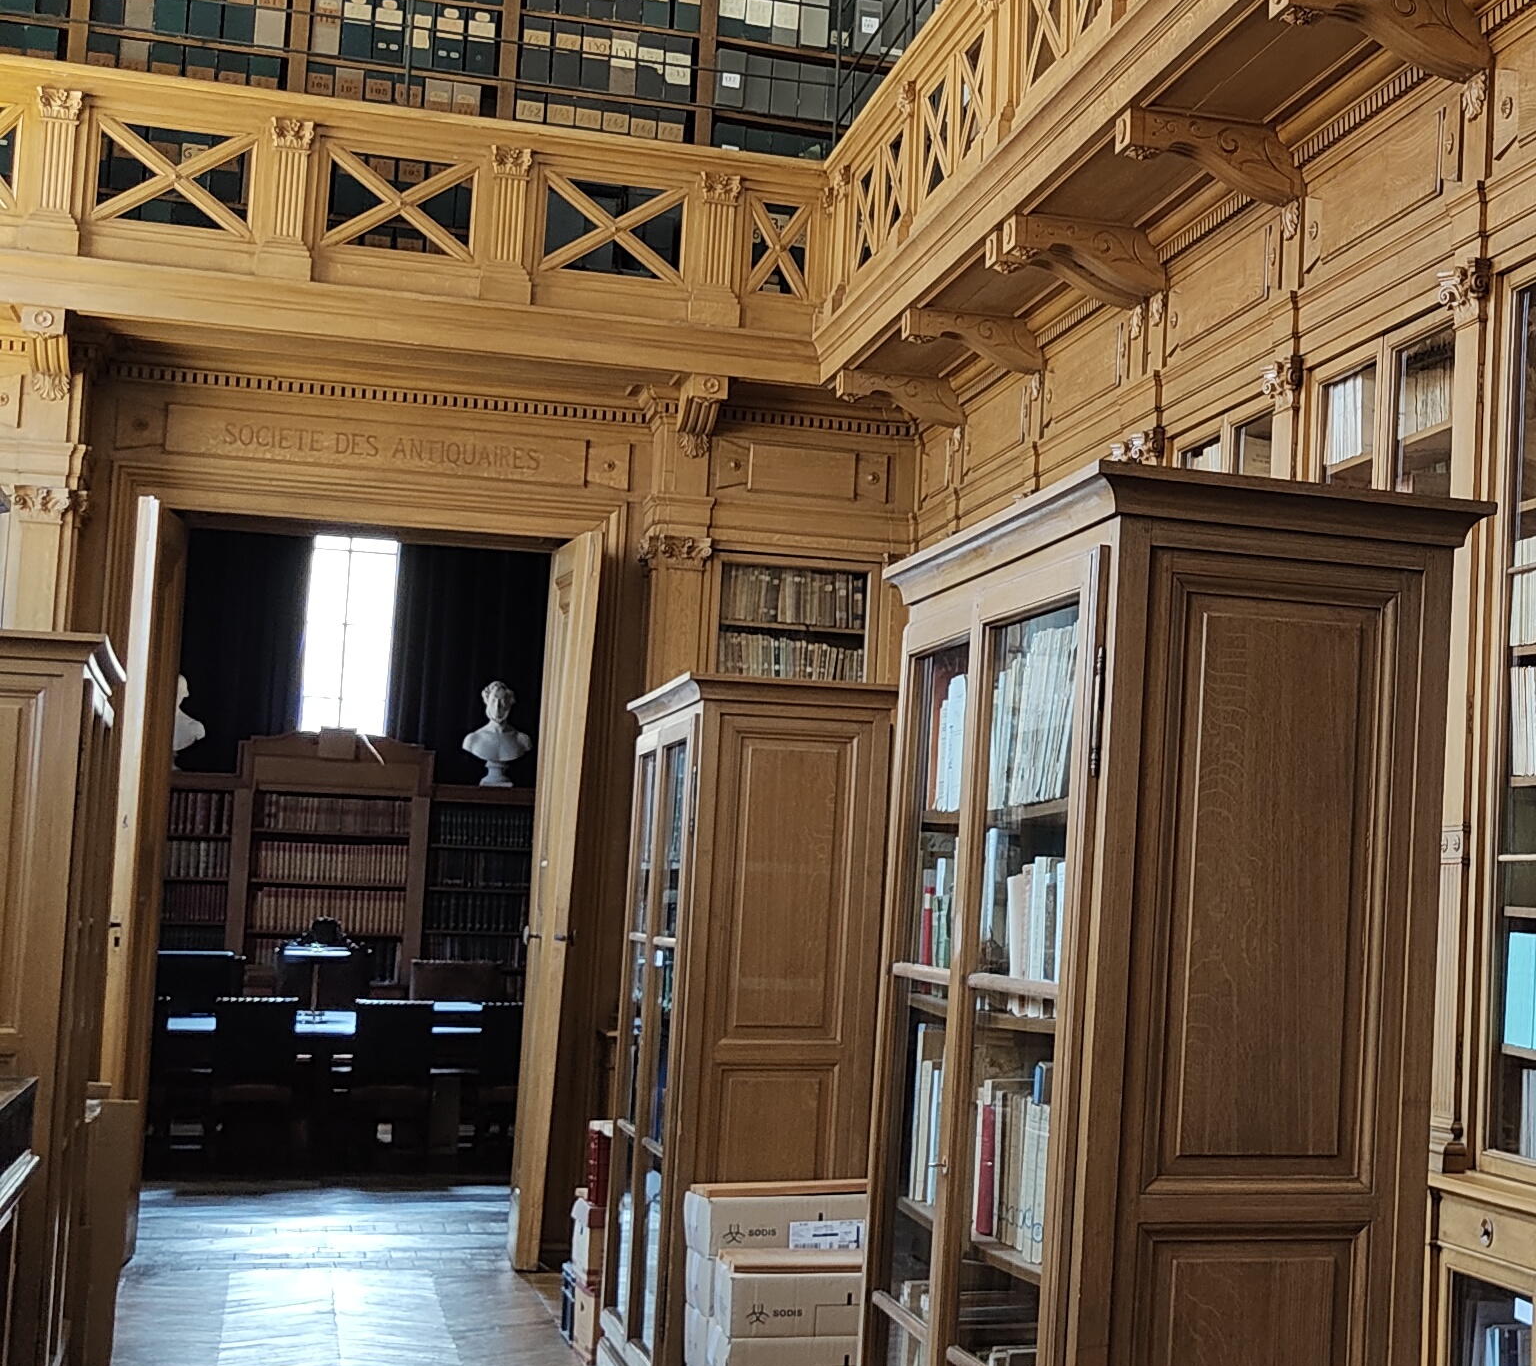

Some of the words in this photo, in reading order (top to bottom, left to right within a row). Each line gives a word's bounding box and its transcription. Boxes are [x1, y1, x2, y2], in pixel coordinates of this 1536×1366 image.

[518, 103, 542, 118] 142
[334, 430, 380, 457] DES
[391, 435, 542, 472] ANTIQUAIRES
[748, 1228, 777, 1237] SODIS
[772, 1308, 803, 1318] SODIS
